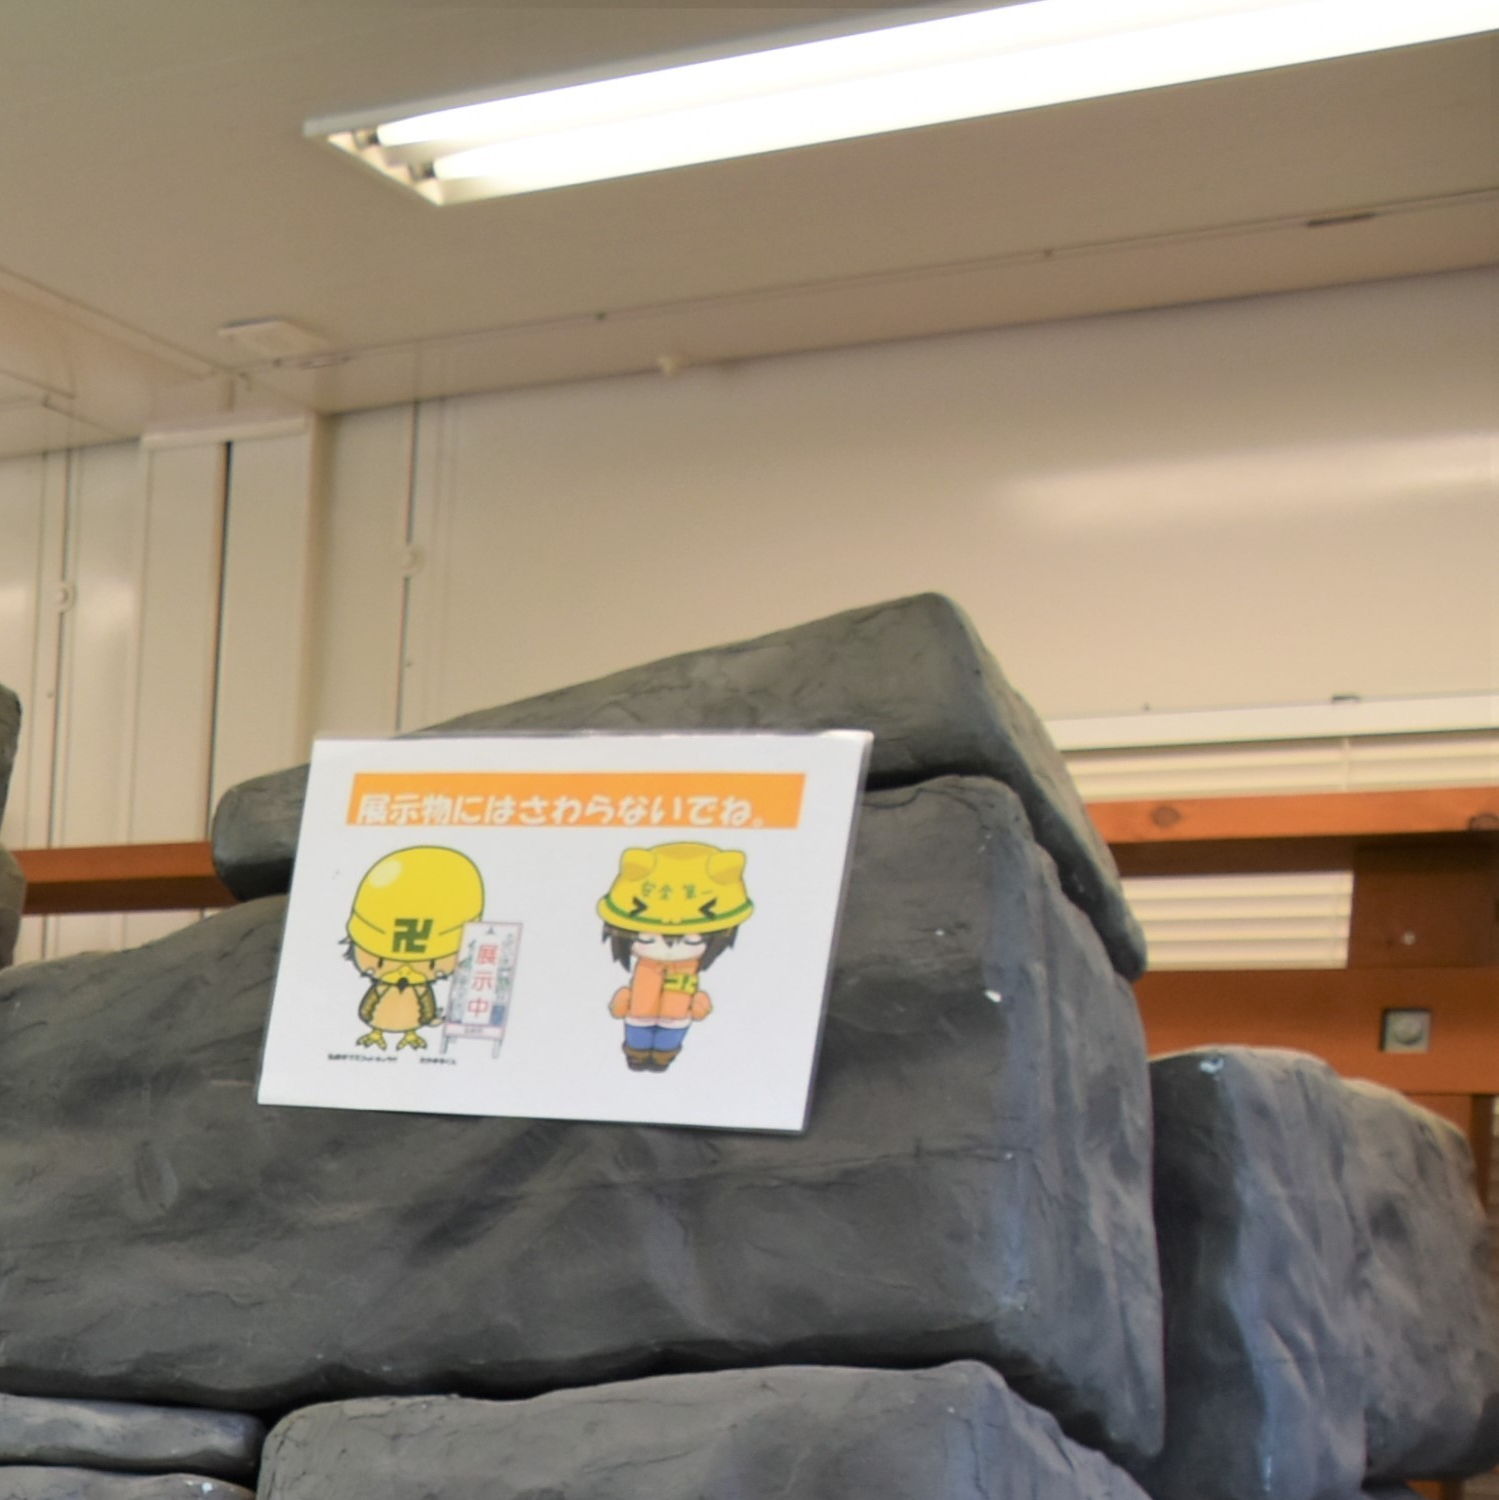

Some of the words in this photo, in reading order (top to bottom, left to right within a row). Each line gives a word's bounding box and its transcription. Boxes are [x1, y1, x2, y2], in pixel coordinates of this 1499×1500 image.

[356, 793, 765, 829] 展示物にはさわらないでね。
[467, 943, 500, 1019] 展示中
